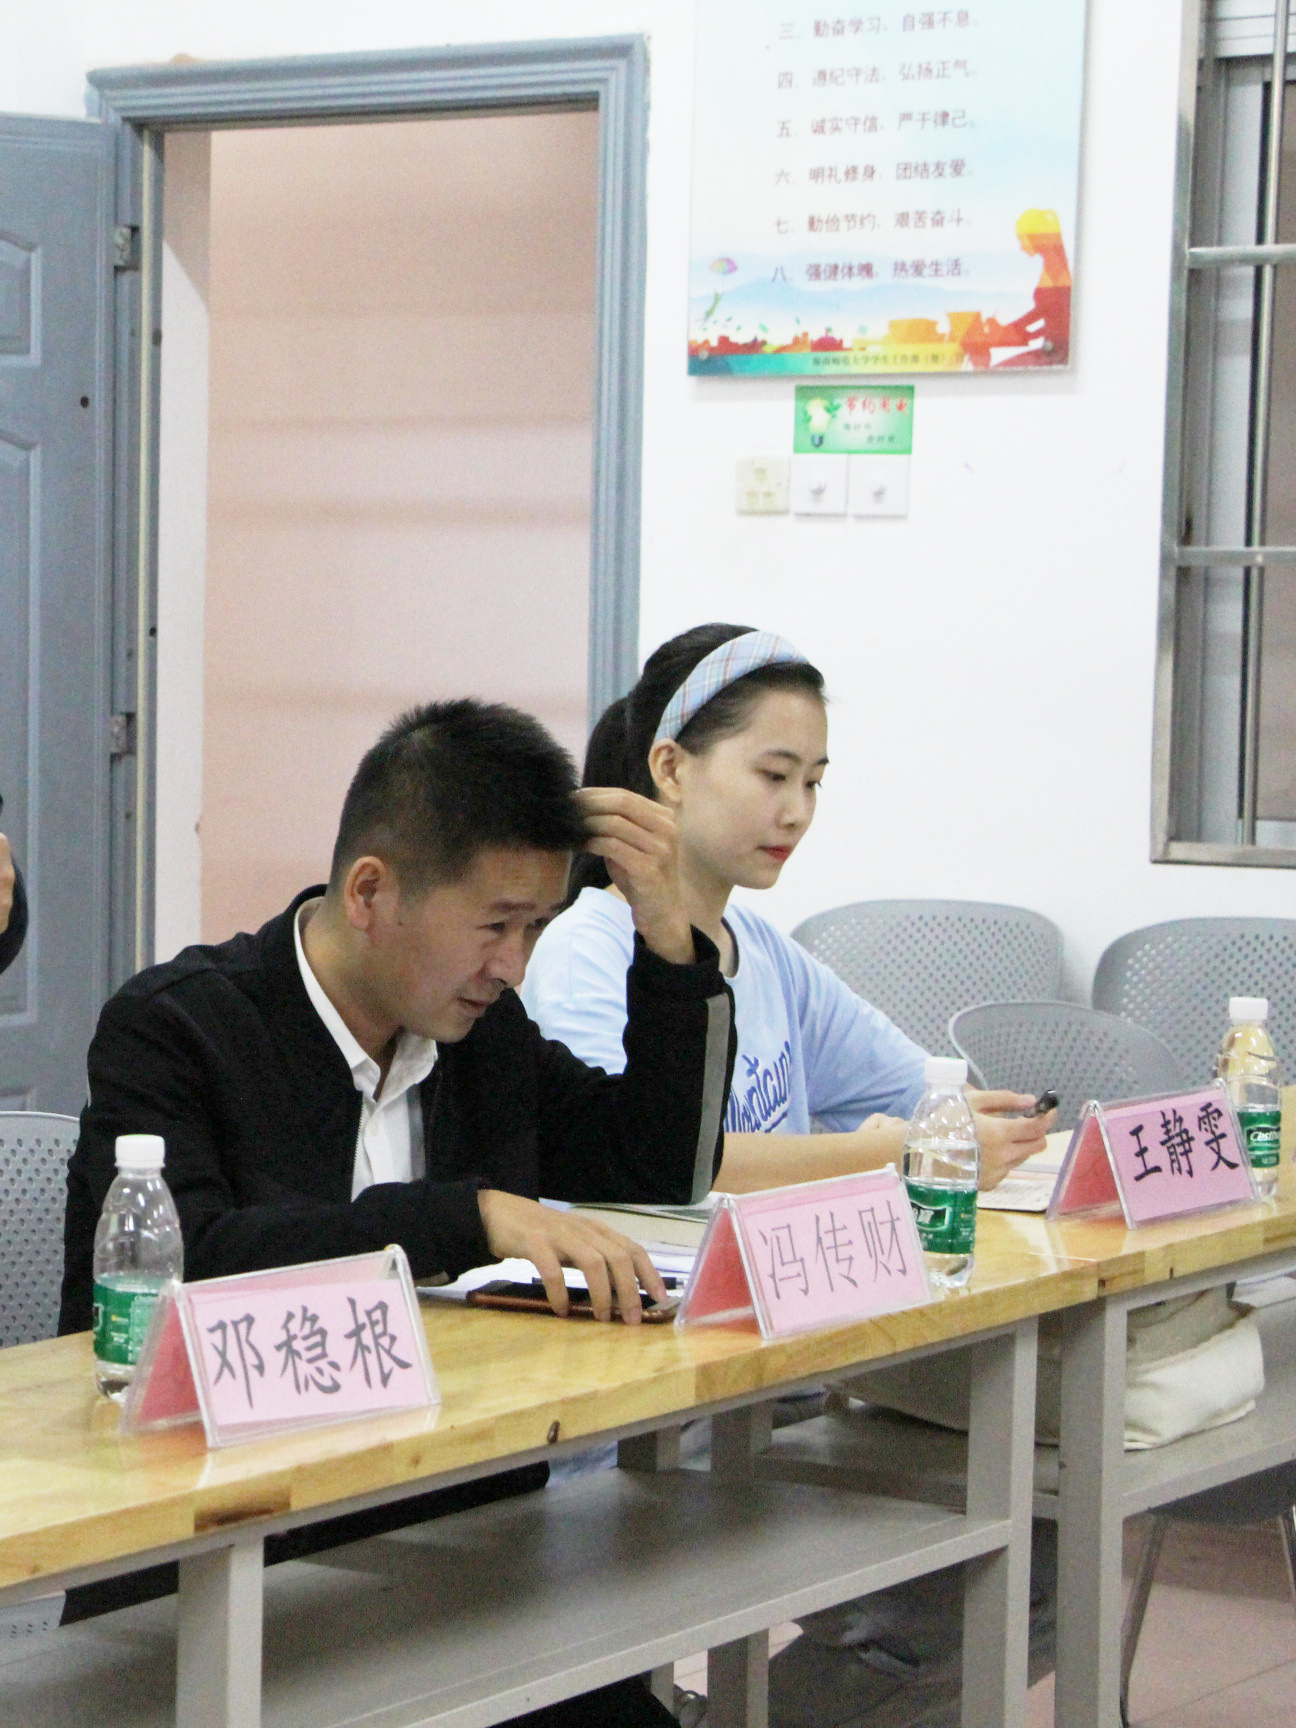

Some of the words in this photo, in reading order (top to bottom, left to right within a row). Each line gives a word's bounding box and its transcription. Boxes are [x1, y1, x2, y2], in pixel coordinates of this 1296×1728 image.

[1129, 1102, 1240, 1182] 王静雯
[758, 1200, 907, 1300] 冯传财
[206, 1296, 413, 1410] 邓稳根
